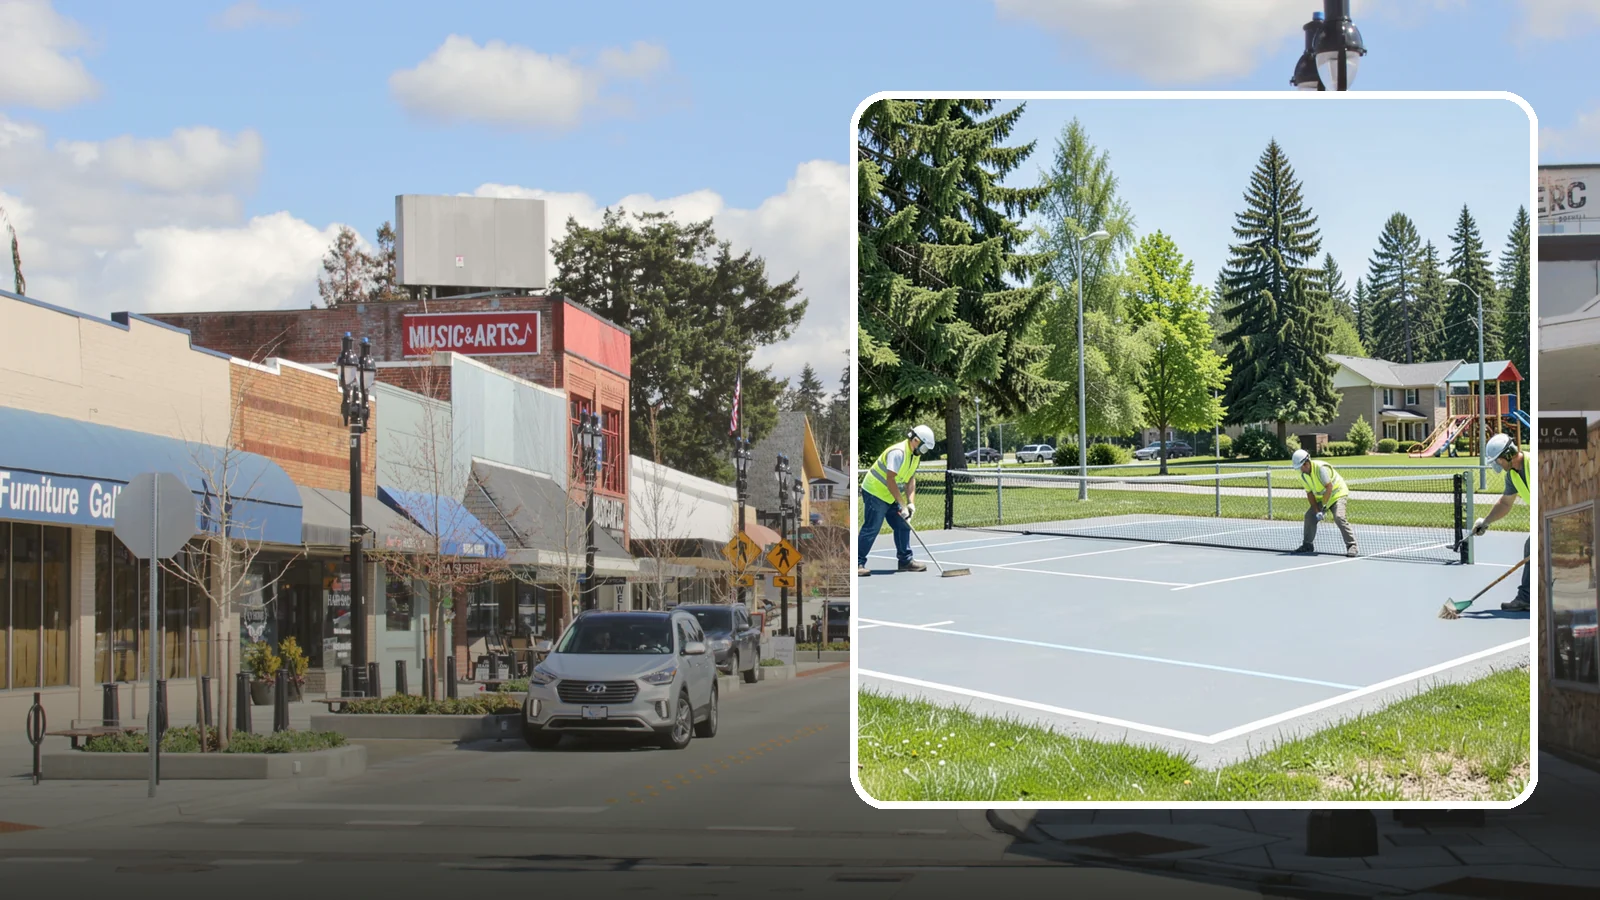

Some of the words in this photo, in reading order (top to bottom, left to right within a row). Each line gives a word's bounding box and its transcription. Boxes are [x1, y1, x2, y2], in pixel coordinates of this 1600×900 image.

[409, 322, 519, 349] MUSIC&ARTS
[0, 471, 79, 515] Furniture
[89, 482, 122, 519] Gal
